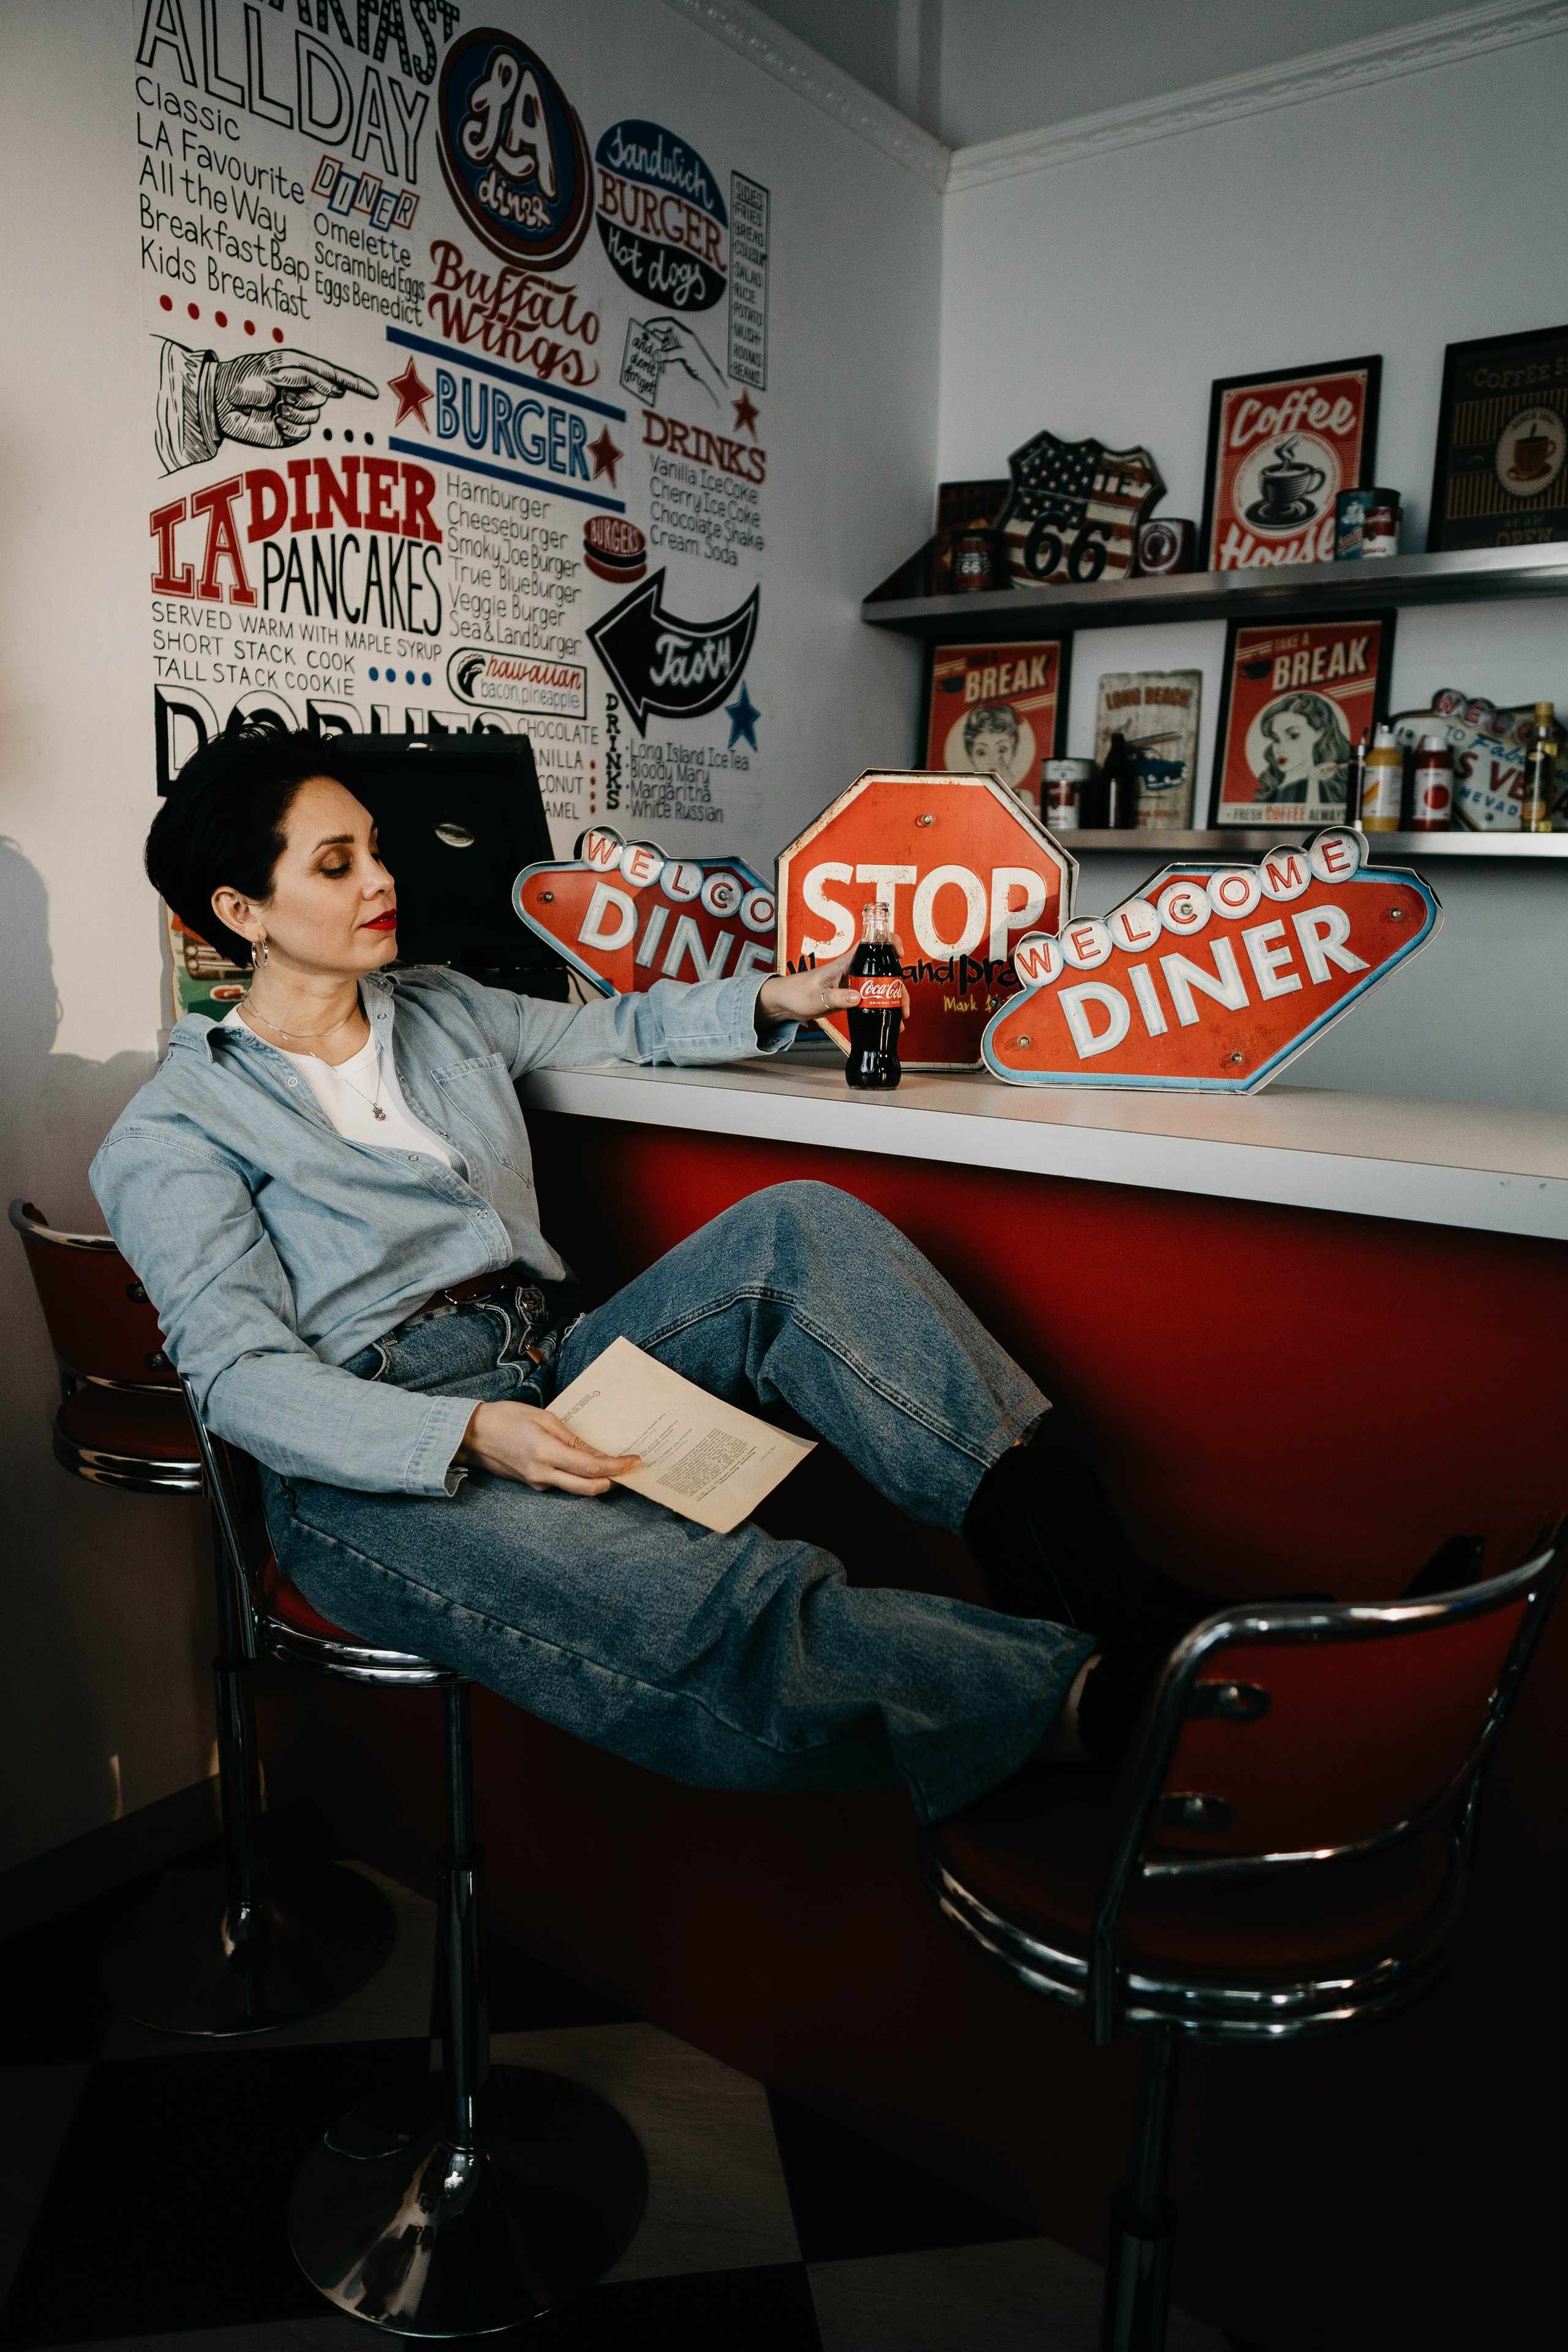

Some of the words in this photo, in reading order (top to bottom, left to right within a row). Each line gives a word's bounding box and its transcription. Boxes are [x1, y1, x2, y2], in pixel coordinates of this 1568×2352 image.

[135, 76, 240, 141] Classic
[295, 29, 429, 185] DAY
[137, 112, 173, 157] LA
[182, 129, 306, 205] Favourite
[140, 155, 173, 197] All
[180, 173, 228, 214] the
[230, 185, 287, 241] Way
[318, 163, 415, 226] DINER
[597, 167, 726, 273] BURGER
[735, 201, 762, 227] FRIES
[736, 181, 763, 209] SIDES
[140, 194, 270, 267] Breakfast
[270, 238, 310, 282] Bap
[314, 213, 411, 268] Omelette
[735, 221, 764, 247] BREAD
[141, 236, 197, 285] Kids
[208, 256, 310, 320] Breakfast
[315, 242, 398, 292] Scrambled
[398, 268, 426, 303] Eggs
[429, 239, 600, 345] Buffalo
[649, 251, 707, 306] dogs
[734, 261, 762, 287] SALAD
[734, 282, 756, 304] RICE
[315, 271, 350, 307] Eggs
[352, 281, 423, 328] Benedict
[734, 302, 763, 327] POTATO
[428, 292, 600, 386] Wings
[734, 342, 762, 368] ROOMS
[1472, 363, 1551, 390] COFFEE
[435, 368, 590, 482] BURGER
[1233, 388, 1357, 448] Coffee
[641, 409, 766, 485] DRINKS
[650, 452, 697, 485] Vanilla
[447, 472, 551, 519] Hamburger
[650, 475, 703, 513] Cherry
[650, 500, 723, 538] Chocolate
[150, 473, 257, 608] LA
[246, 456, 442, 543] DINER
[447, 500, 569, 551] Cheeseburger
[650, 524, 699, 554] Cream
[704, 533, 738, 566] Soda
[1024, 511, 1114, 583] 66
[447, 526, 500, 568] Smoky
[502, 538, 529, 567] Joe
[530, 543, 581, 580] Burger
[262, 533, 442, 636] PANCAKES
[448, 554, 492, 587] True
[499, 565, 530, 594] Blue
[530, 570, 581, 608] Burger
[448, 581, 507, 621] Veggie
[512, 594, 566, 630] Burger
[152, 601, 232, 630] SERVED
[239, 614, 294, 639] WARM
[298, 624, 339, 646] WITH
[344, 630, 392, 655] MAPLE
[396, 638, 442, 662] SYRUP
[153, 629, 223, 657] SHORT
[234, 640, 296, 666] STACK
[306, 650, 356, 674] COOK
[449, 609, 481, 641] Sea
[483, 620, 495, 642] &
[496, 619, 531, 649] Land
[532, 624, 582, 659] Burger
[153, 655, 207, 682] TALL
[213, 663, 277, 690] STACK
[284, 671, 355, 696] COOKIE
[486, 654, 582, 690] hawaiian
[964, 653, 1049, 706] BREAK
[1272, 636, 1372, 693] BREAK
[517, 717, 599, 745] CHOCOLATE
[605, 693, 622, 810] DRINKS
[630, 737, 663, 765] Long
[665, 741, 705, 766] Island
[1446, 725, 1466, 741] TO
[537, 774, 584, 794] CONUT
[630, 758, 673, 785] Bloody
[676, 764, 710, 788] Mary
[545, 801, 581, 820] AMEL
[630, 799, 671, 820] White
[674, 801, 724, 823] Russian
[1232, 807, 1263, 821] FRESH
[1265, 805, 1307, 822] COFFEE
[1459, 787, 1520, 818] NEVAD
[588, 832, 774, 924] WELCO
[801, 861, 1047, 963] STOP
[1017, 839, 1351, 980] WELCOME
[943, 993, 978, 1013] Mark
[1057, 903, 1371, 1060] DINER
